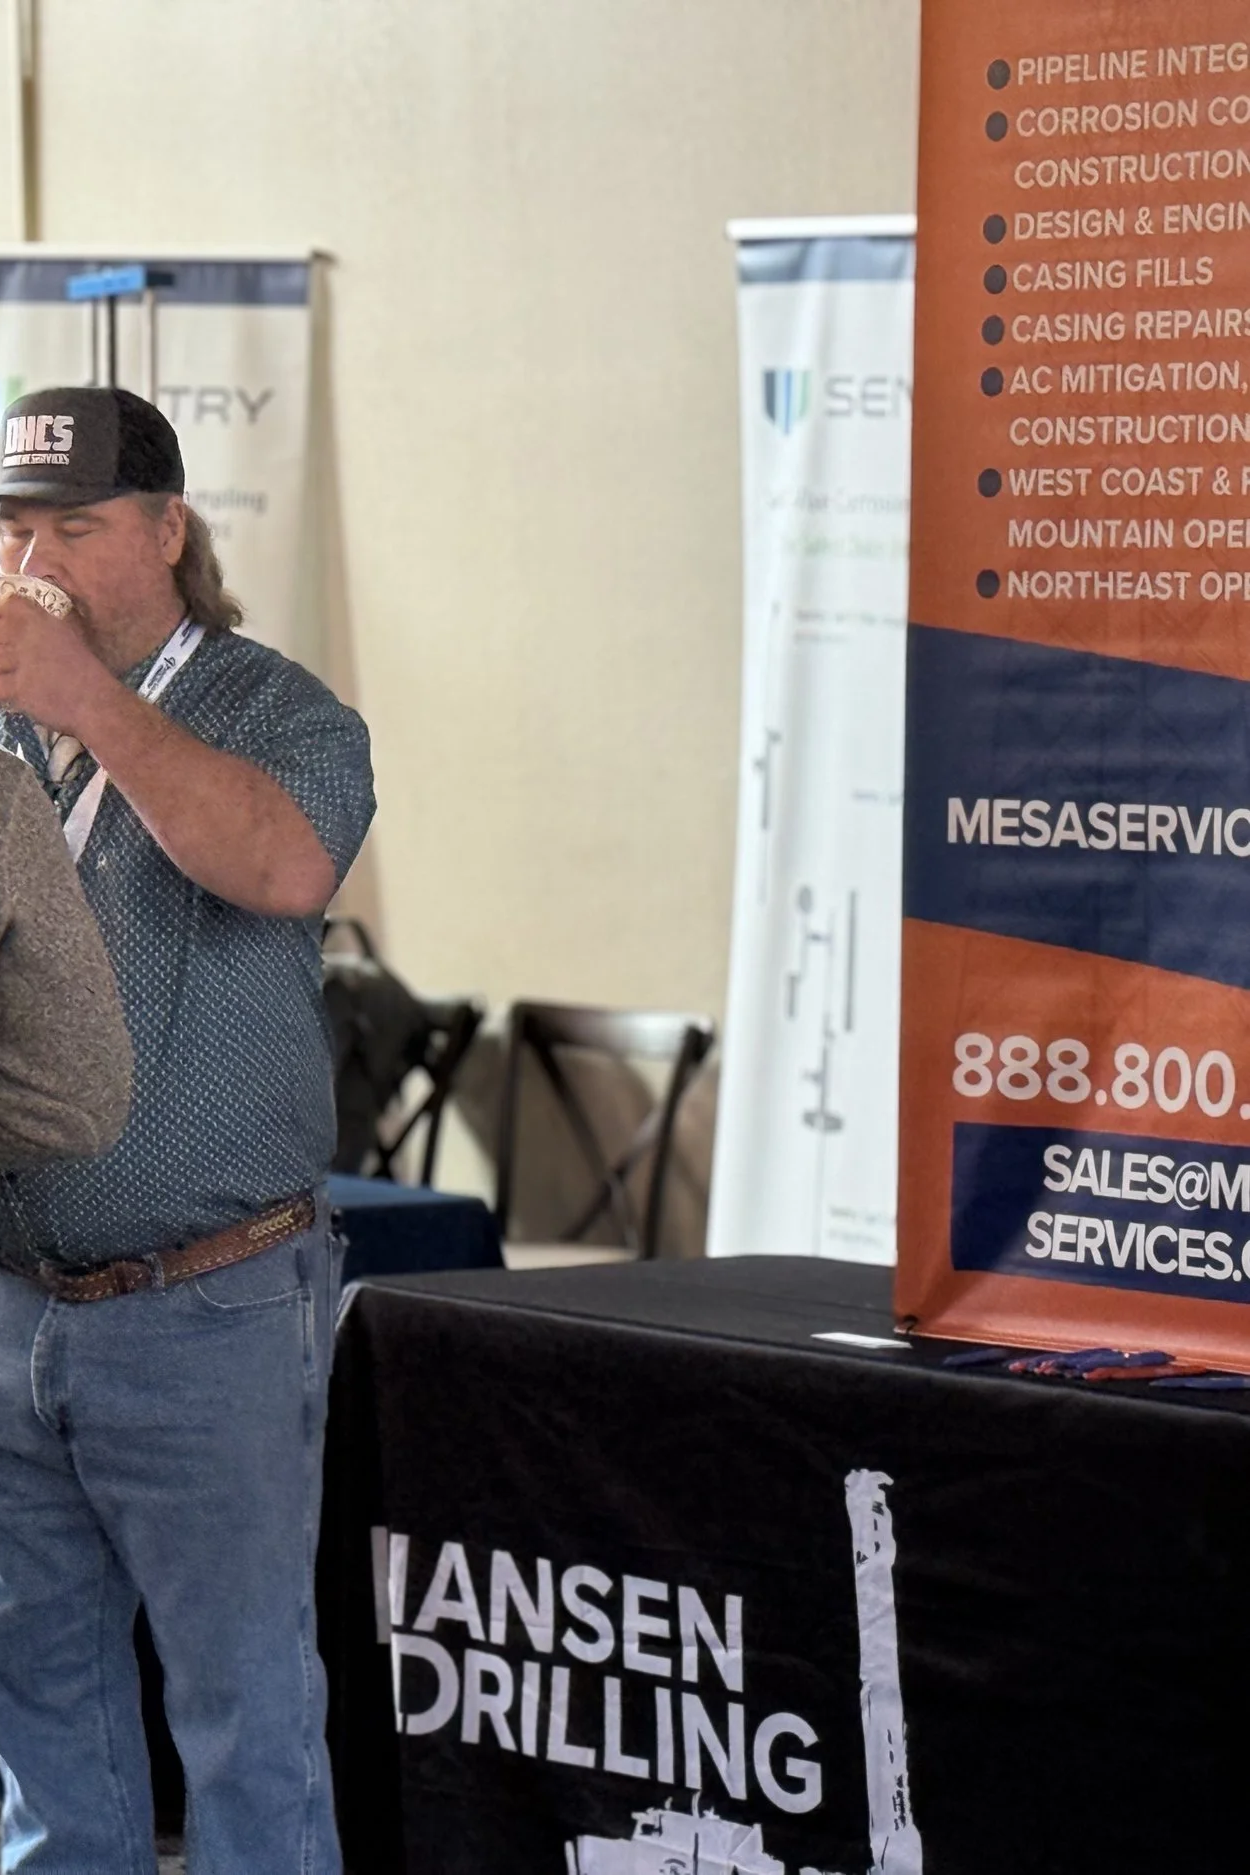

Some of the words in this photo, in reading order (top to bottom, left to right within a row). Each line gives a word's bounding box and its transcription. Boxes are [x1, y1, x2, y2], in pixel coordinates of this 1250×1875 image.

[1018, 49, 1147, 86] PIPELINE
[1158, 42, 1248, 77] INTEG
[1016, 98, 1198, 137] CORROSION
[1208, 95, 1250, 127] CO
[1014, 208, 1125, 241] DESIGN
[1134, 206, 1154, 236] &
[1012, 260, 1126, 292] CASING
[1136, 256, 1213, 288] FILLS
[1011, 312, 1126, 343] CASING
[1010, 366, 1052, 395] AC
[1061, 360, 1248, 394] MITIGATION,
[157, 385, 277, 426] TRY
[1009, 413, 1250, 446] CONSTRUCTION
[1008, 467, 1092, 496] WEST
[1100, 466, 1204, 496] COAST
[1212, 466, 1232, 496] &
[1008, 518, 1174, 549] MOUNTAIN
[1183, 518, 1250, 549] OPE
[1007, 571, 1191, 601] NORTHEAST
[948, 797, 1250, 858] MESASERVIC
[1043, 1144, 1250, 1212] SALES@M
[390, 1632, 822, 1814] DRILLING
